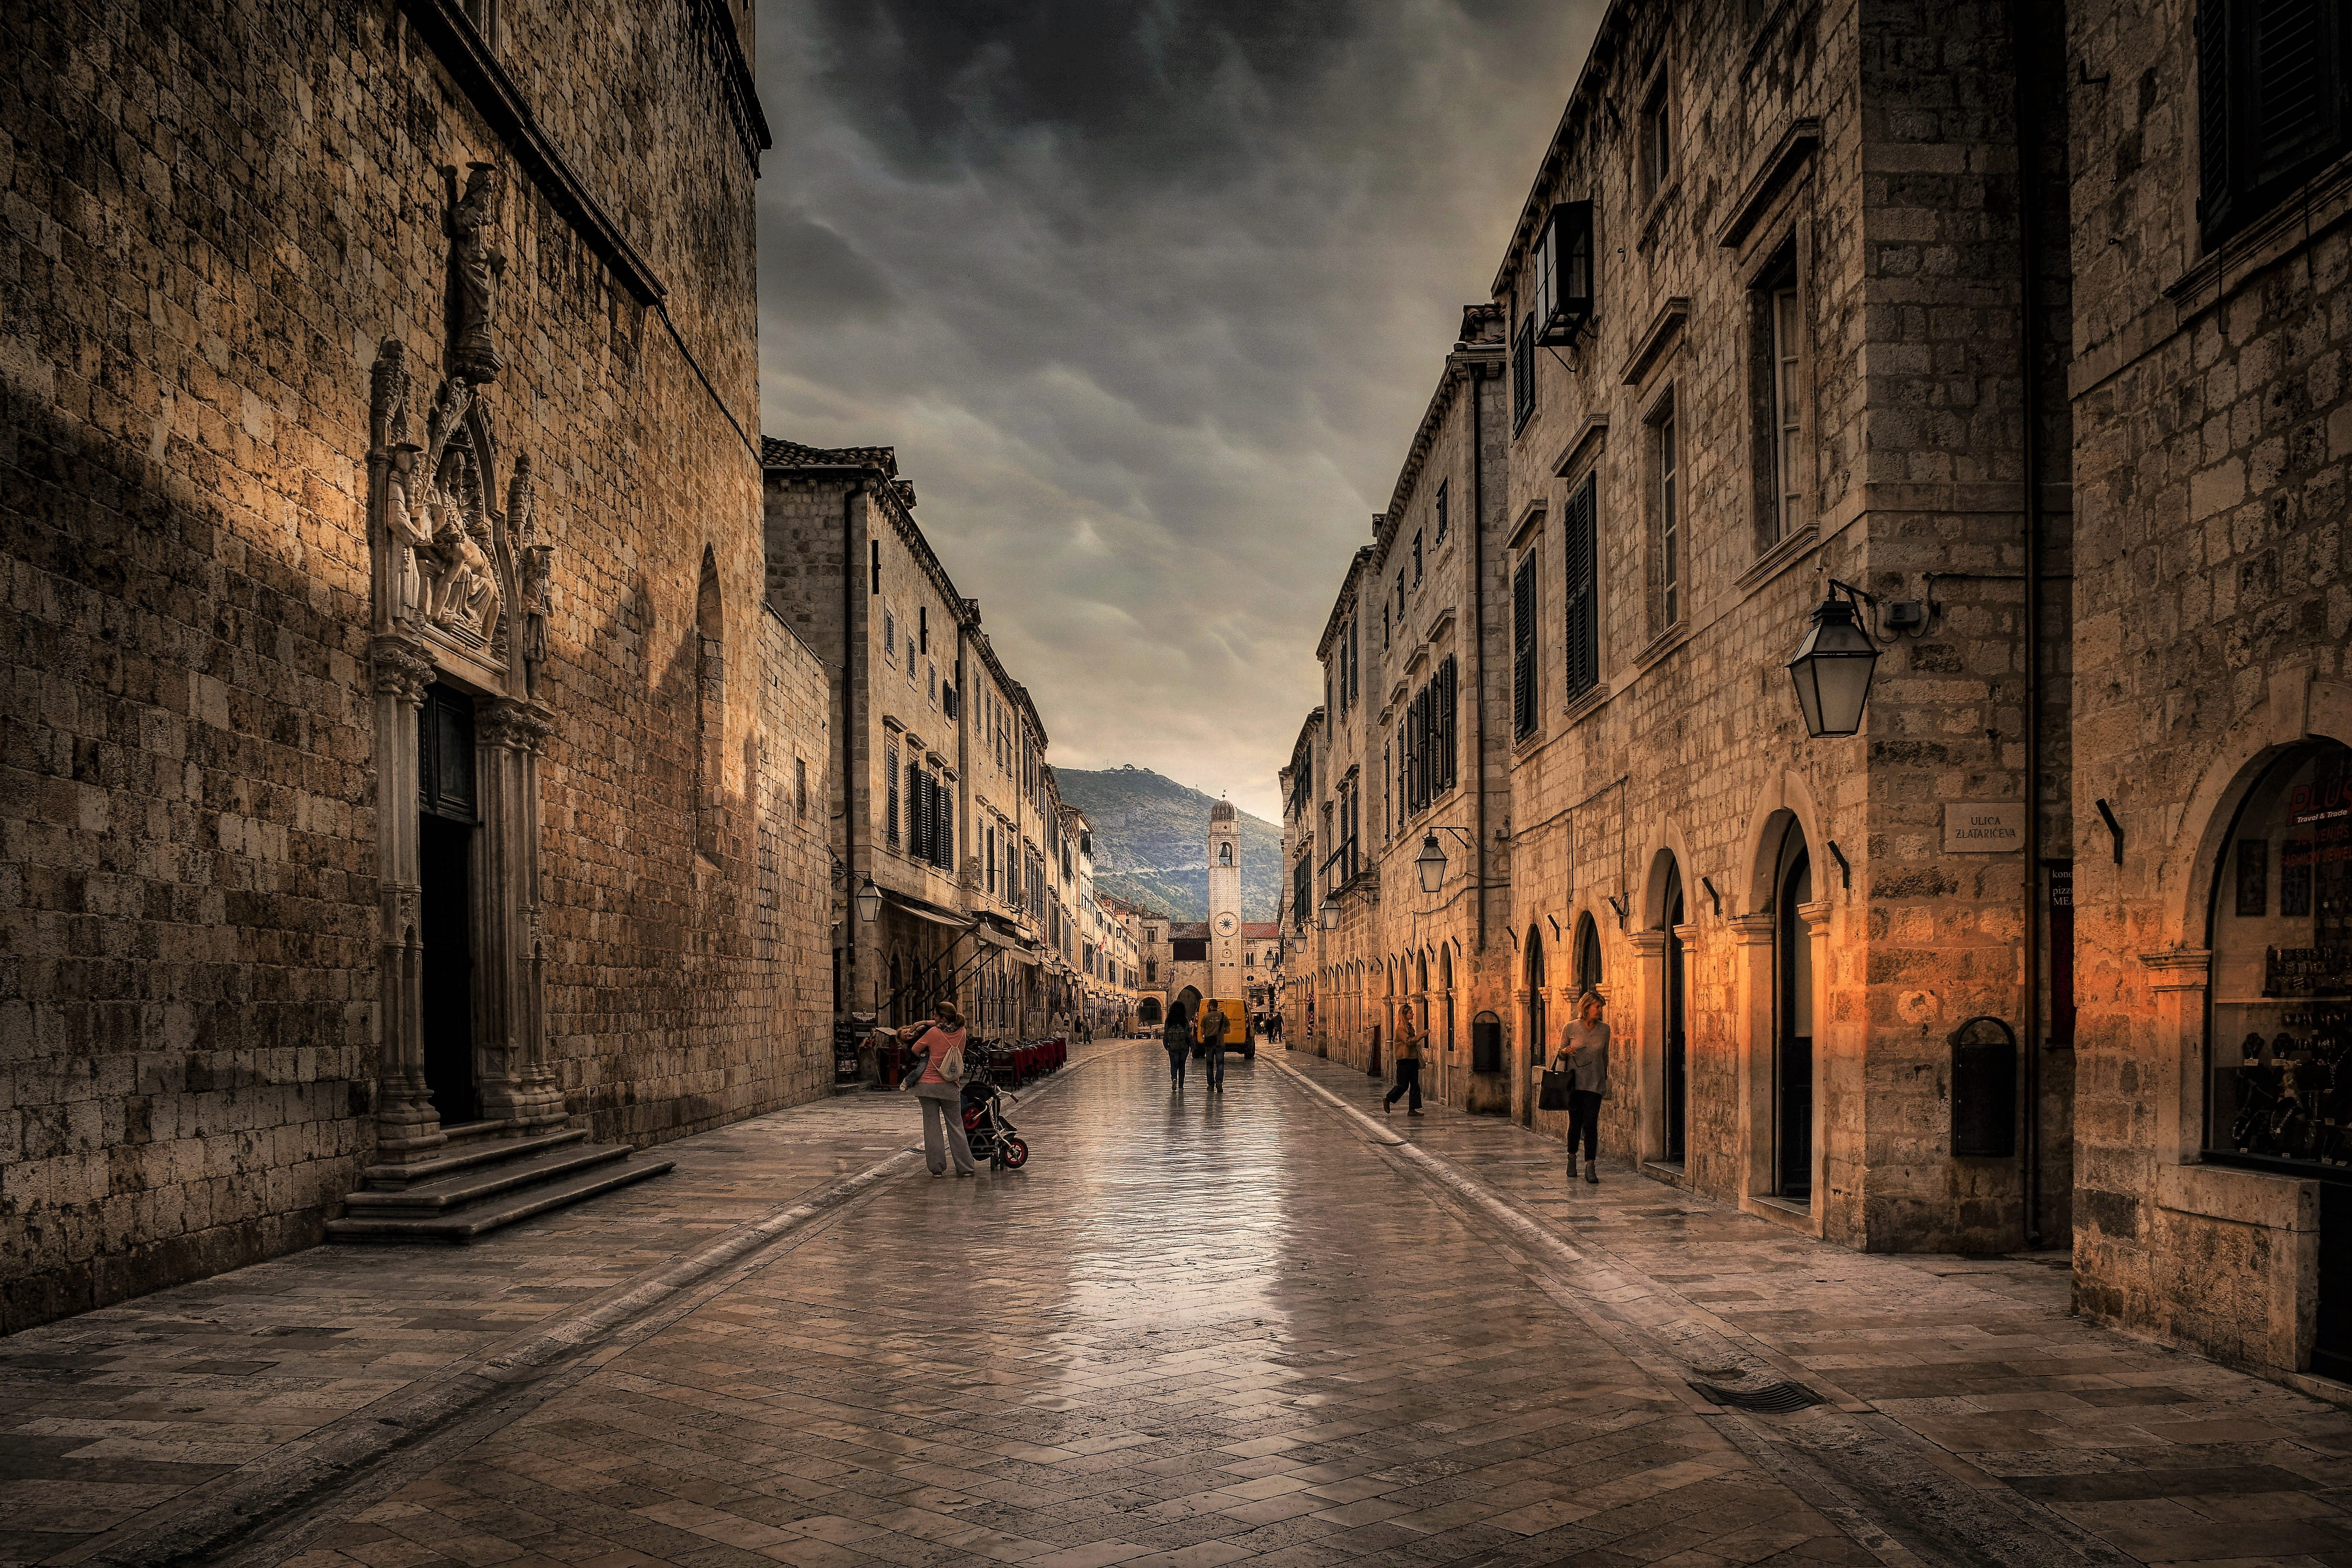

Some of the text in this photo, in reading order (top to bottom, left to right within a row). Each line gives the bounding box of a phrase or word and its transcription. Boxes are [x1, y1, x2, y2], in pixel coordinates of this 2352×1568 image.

[1971, 817, 2001, 826] ULICA
[2297, 814, 2318, 823] Travel
[2296, 824, 2350, 846] SOUVENIRS
[2281, 851, 2320, 867] FASHION
